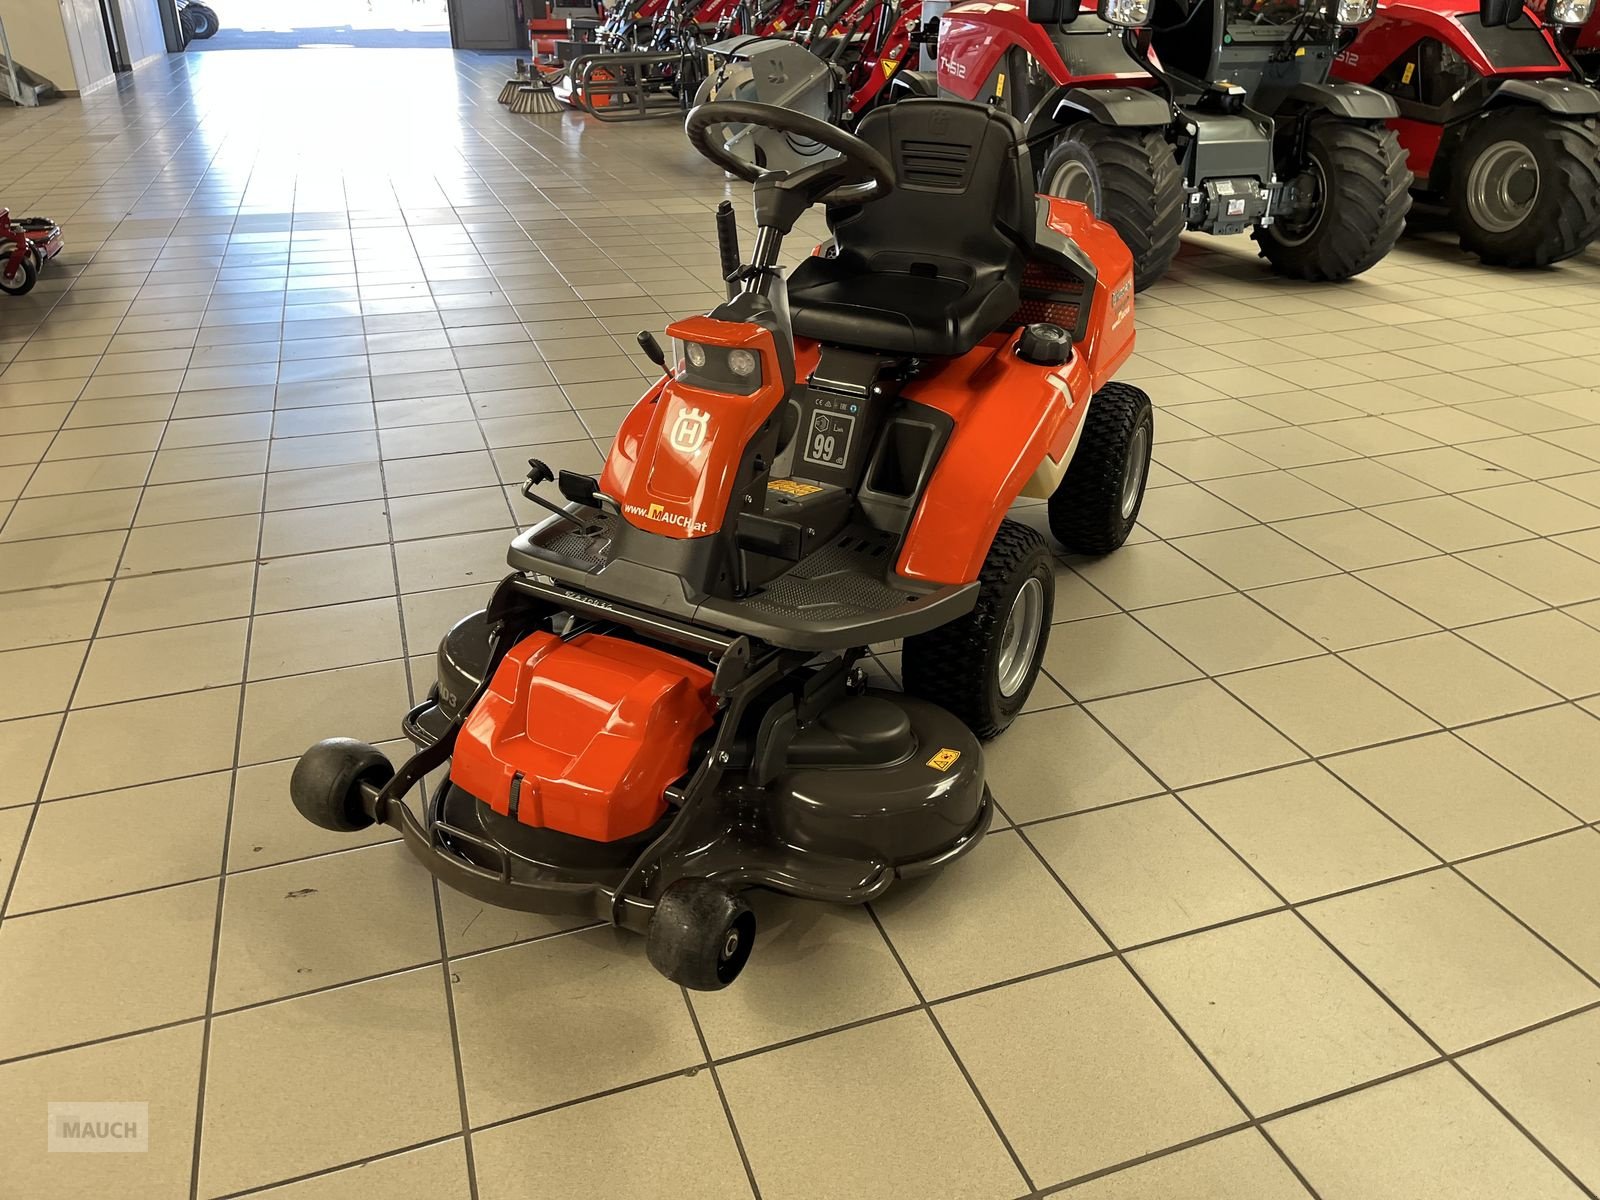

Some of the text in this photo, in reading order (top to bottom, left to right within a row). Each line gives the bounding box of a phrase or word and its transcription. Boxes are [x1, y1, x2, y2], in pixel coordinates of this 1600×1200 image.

[940, 55, 966, 79] T4512
[812, 433, 835, 461] 99
[624, 504, 708, 532] www.MAUCH.at
